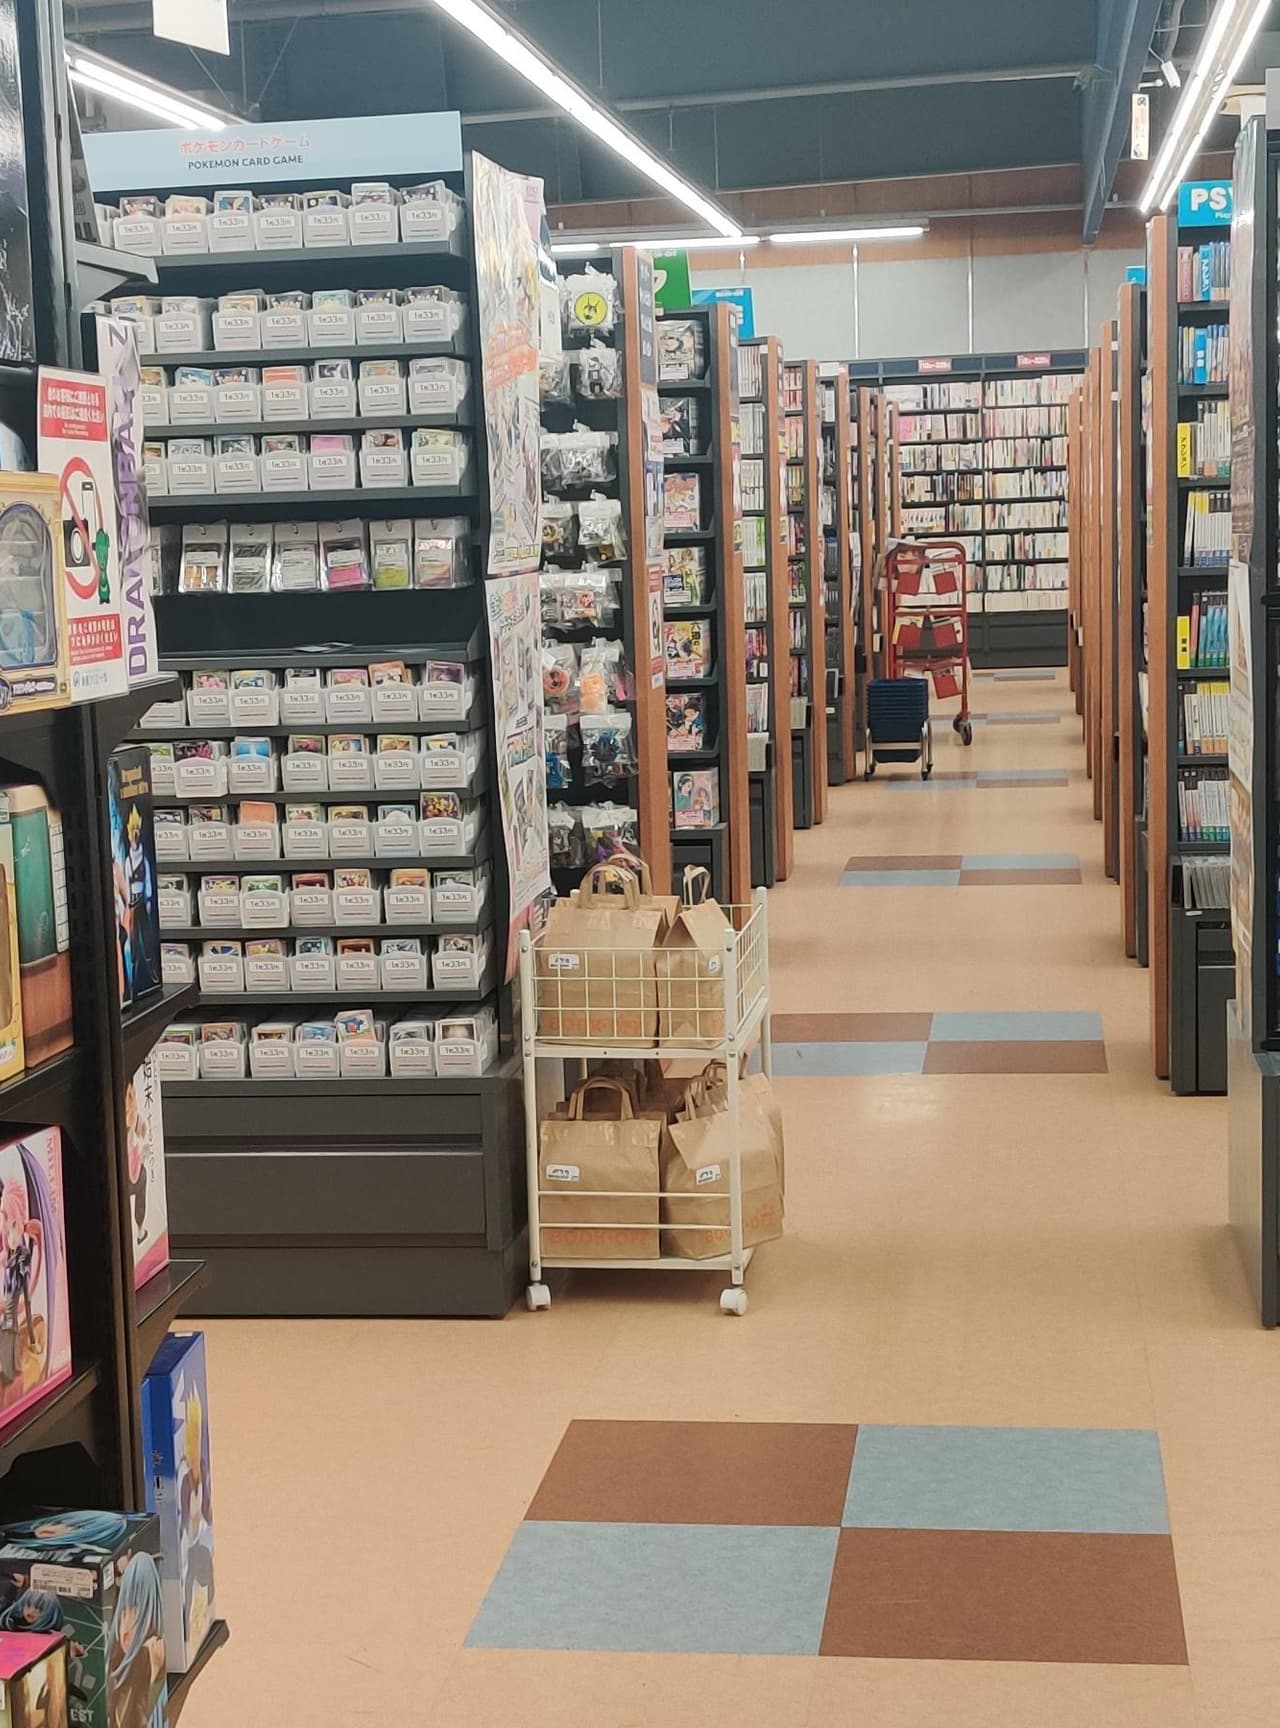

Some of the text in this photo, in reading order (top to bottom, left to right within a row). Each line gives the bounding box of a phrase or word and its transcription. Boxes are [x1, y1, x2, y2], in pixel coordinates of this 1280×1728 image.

[180, 136, 310, 154] ポケモンカードゲーム
[188, 154, 303, 169] POKEMON CARD GAME
